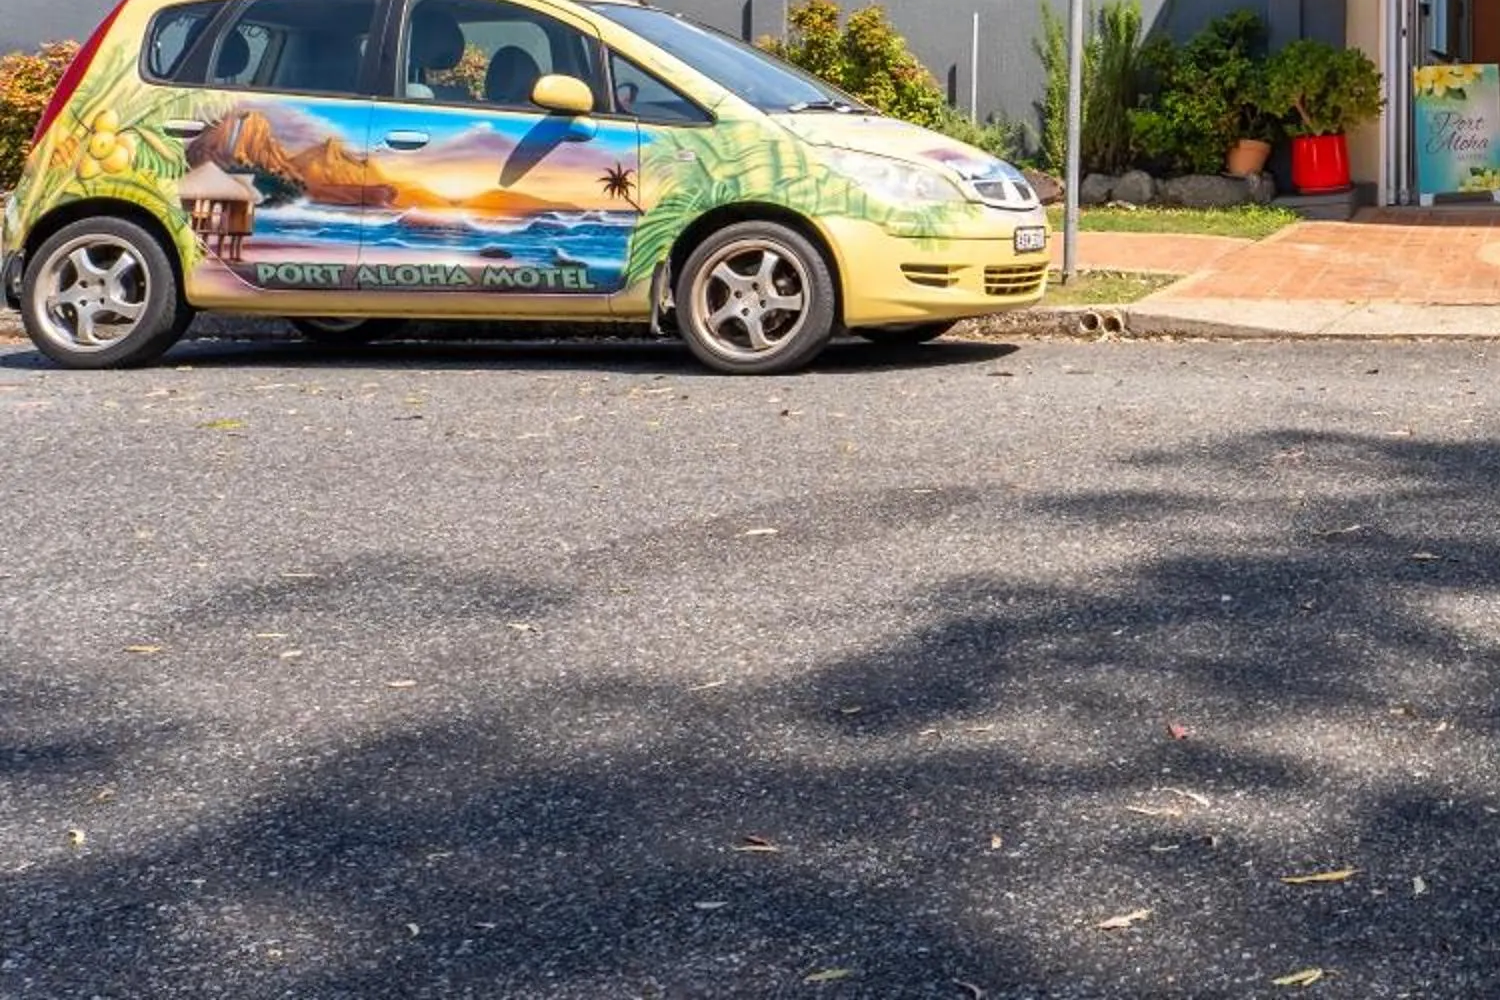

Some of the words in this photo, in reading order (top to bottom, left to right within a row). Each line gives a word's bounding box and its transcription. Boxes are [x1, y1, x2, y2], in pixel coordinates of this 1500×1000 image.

[256, 263, 346, 285] PORT
[355, 263, 474, 287] ALOHA
[482, 265, 596, 290] MOTEL
